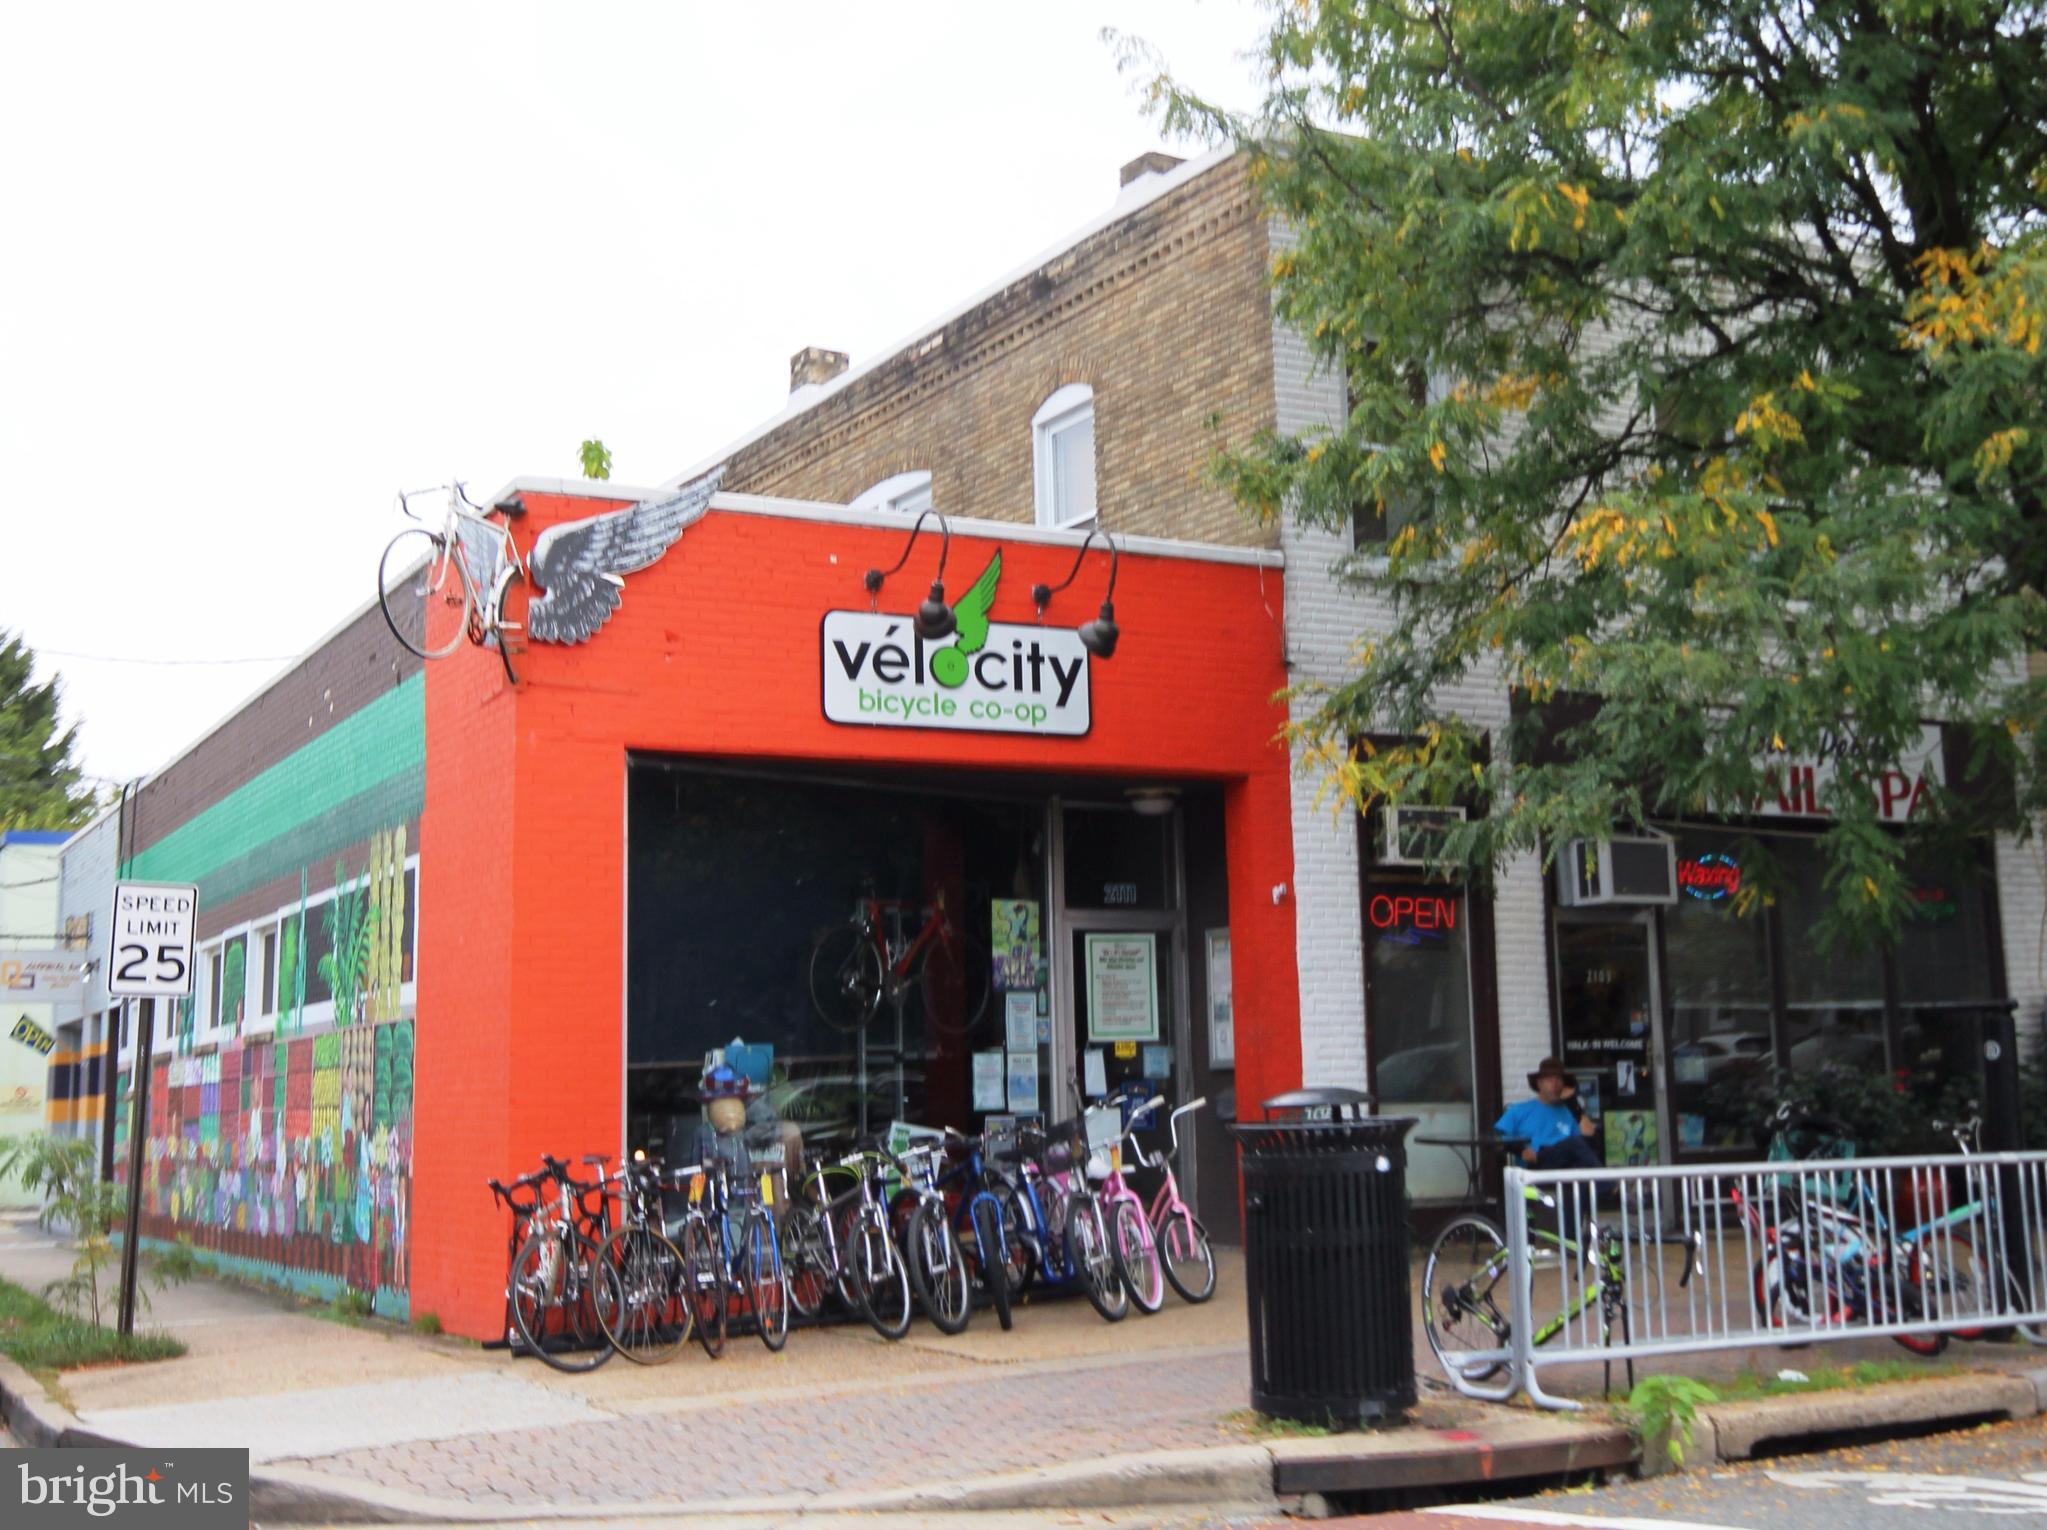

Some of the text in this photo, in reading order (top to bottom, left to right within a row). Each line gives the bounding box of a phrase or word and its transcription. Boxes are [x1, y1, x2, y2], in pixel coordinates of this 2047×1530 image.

[833, 624, 1084, 709] vélocity
[859, 688, 1047, 727] bicycle co-op
[1678, 860, 1740, 895] Waxing
[122, 895, 190, 913] SPEED
[1369, 894, 1456, 930] OPEN
[127, 919, 181, 936] LIMIT
[116, 944, 186, 983] 25
